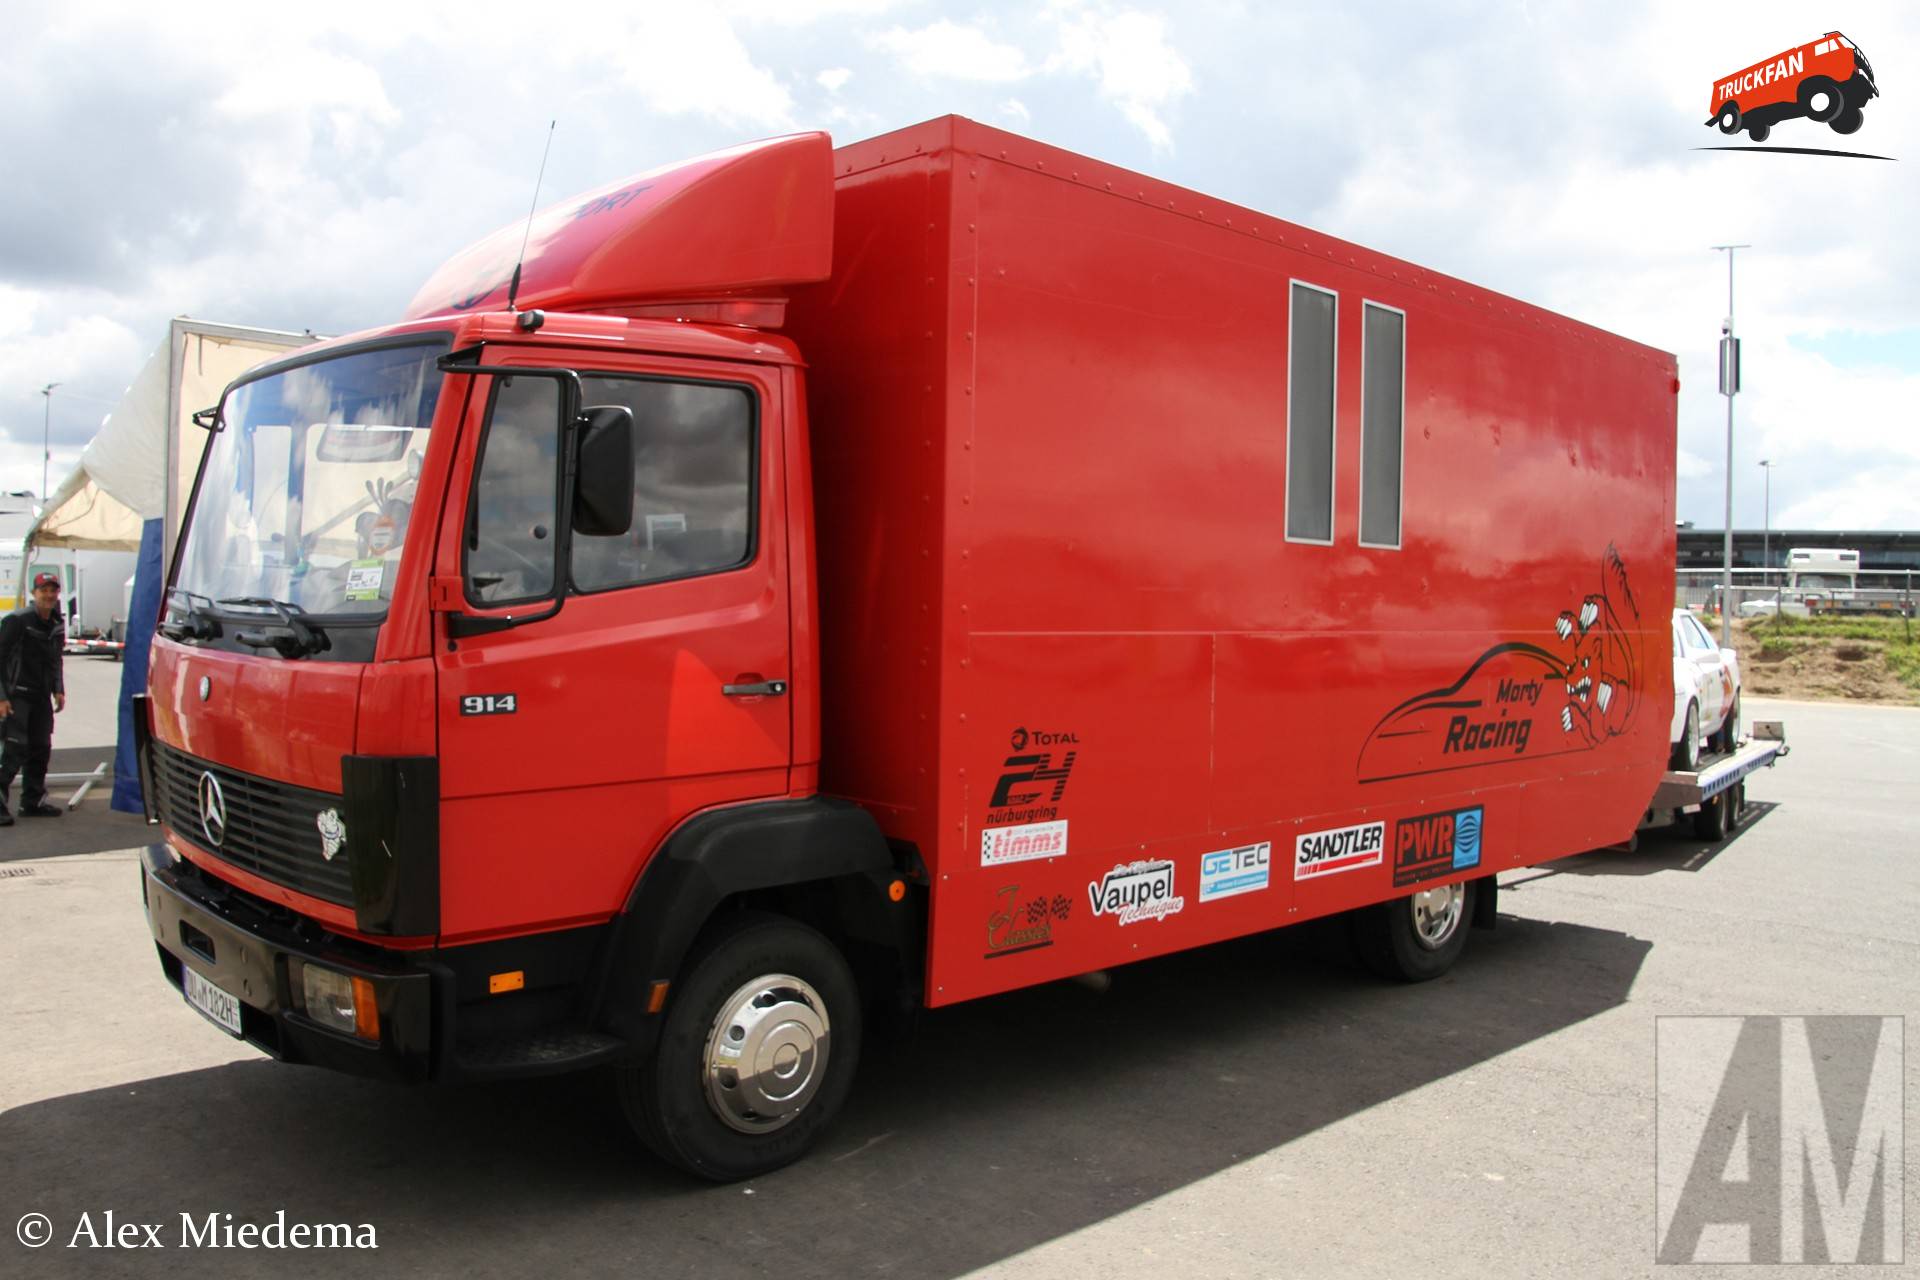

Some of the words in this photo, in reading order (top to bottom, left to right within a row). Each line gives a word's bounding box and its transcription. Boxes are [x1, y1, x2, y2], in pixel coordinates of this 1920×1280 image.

[463, 695, 516, 714] 914
[1495, 678, 1543, 707] Marty
[1443, 708, 1532, 754] Racing
[993, 829, 1063, 858] timms
[1299, 825, 1383, 865] SANDTLER
[1396, 815, 1455, 866] PWR
[1202, 843, 1270, 876] GETEC
[1090, 864, 1173, 913] Vaupel
